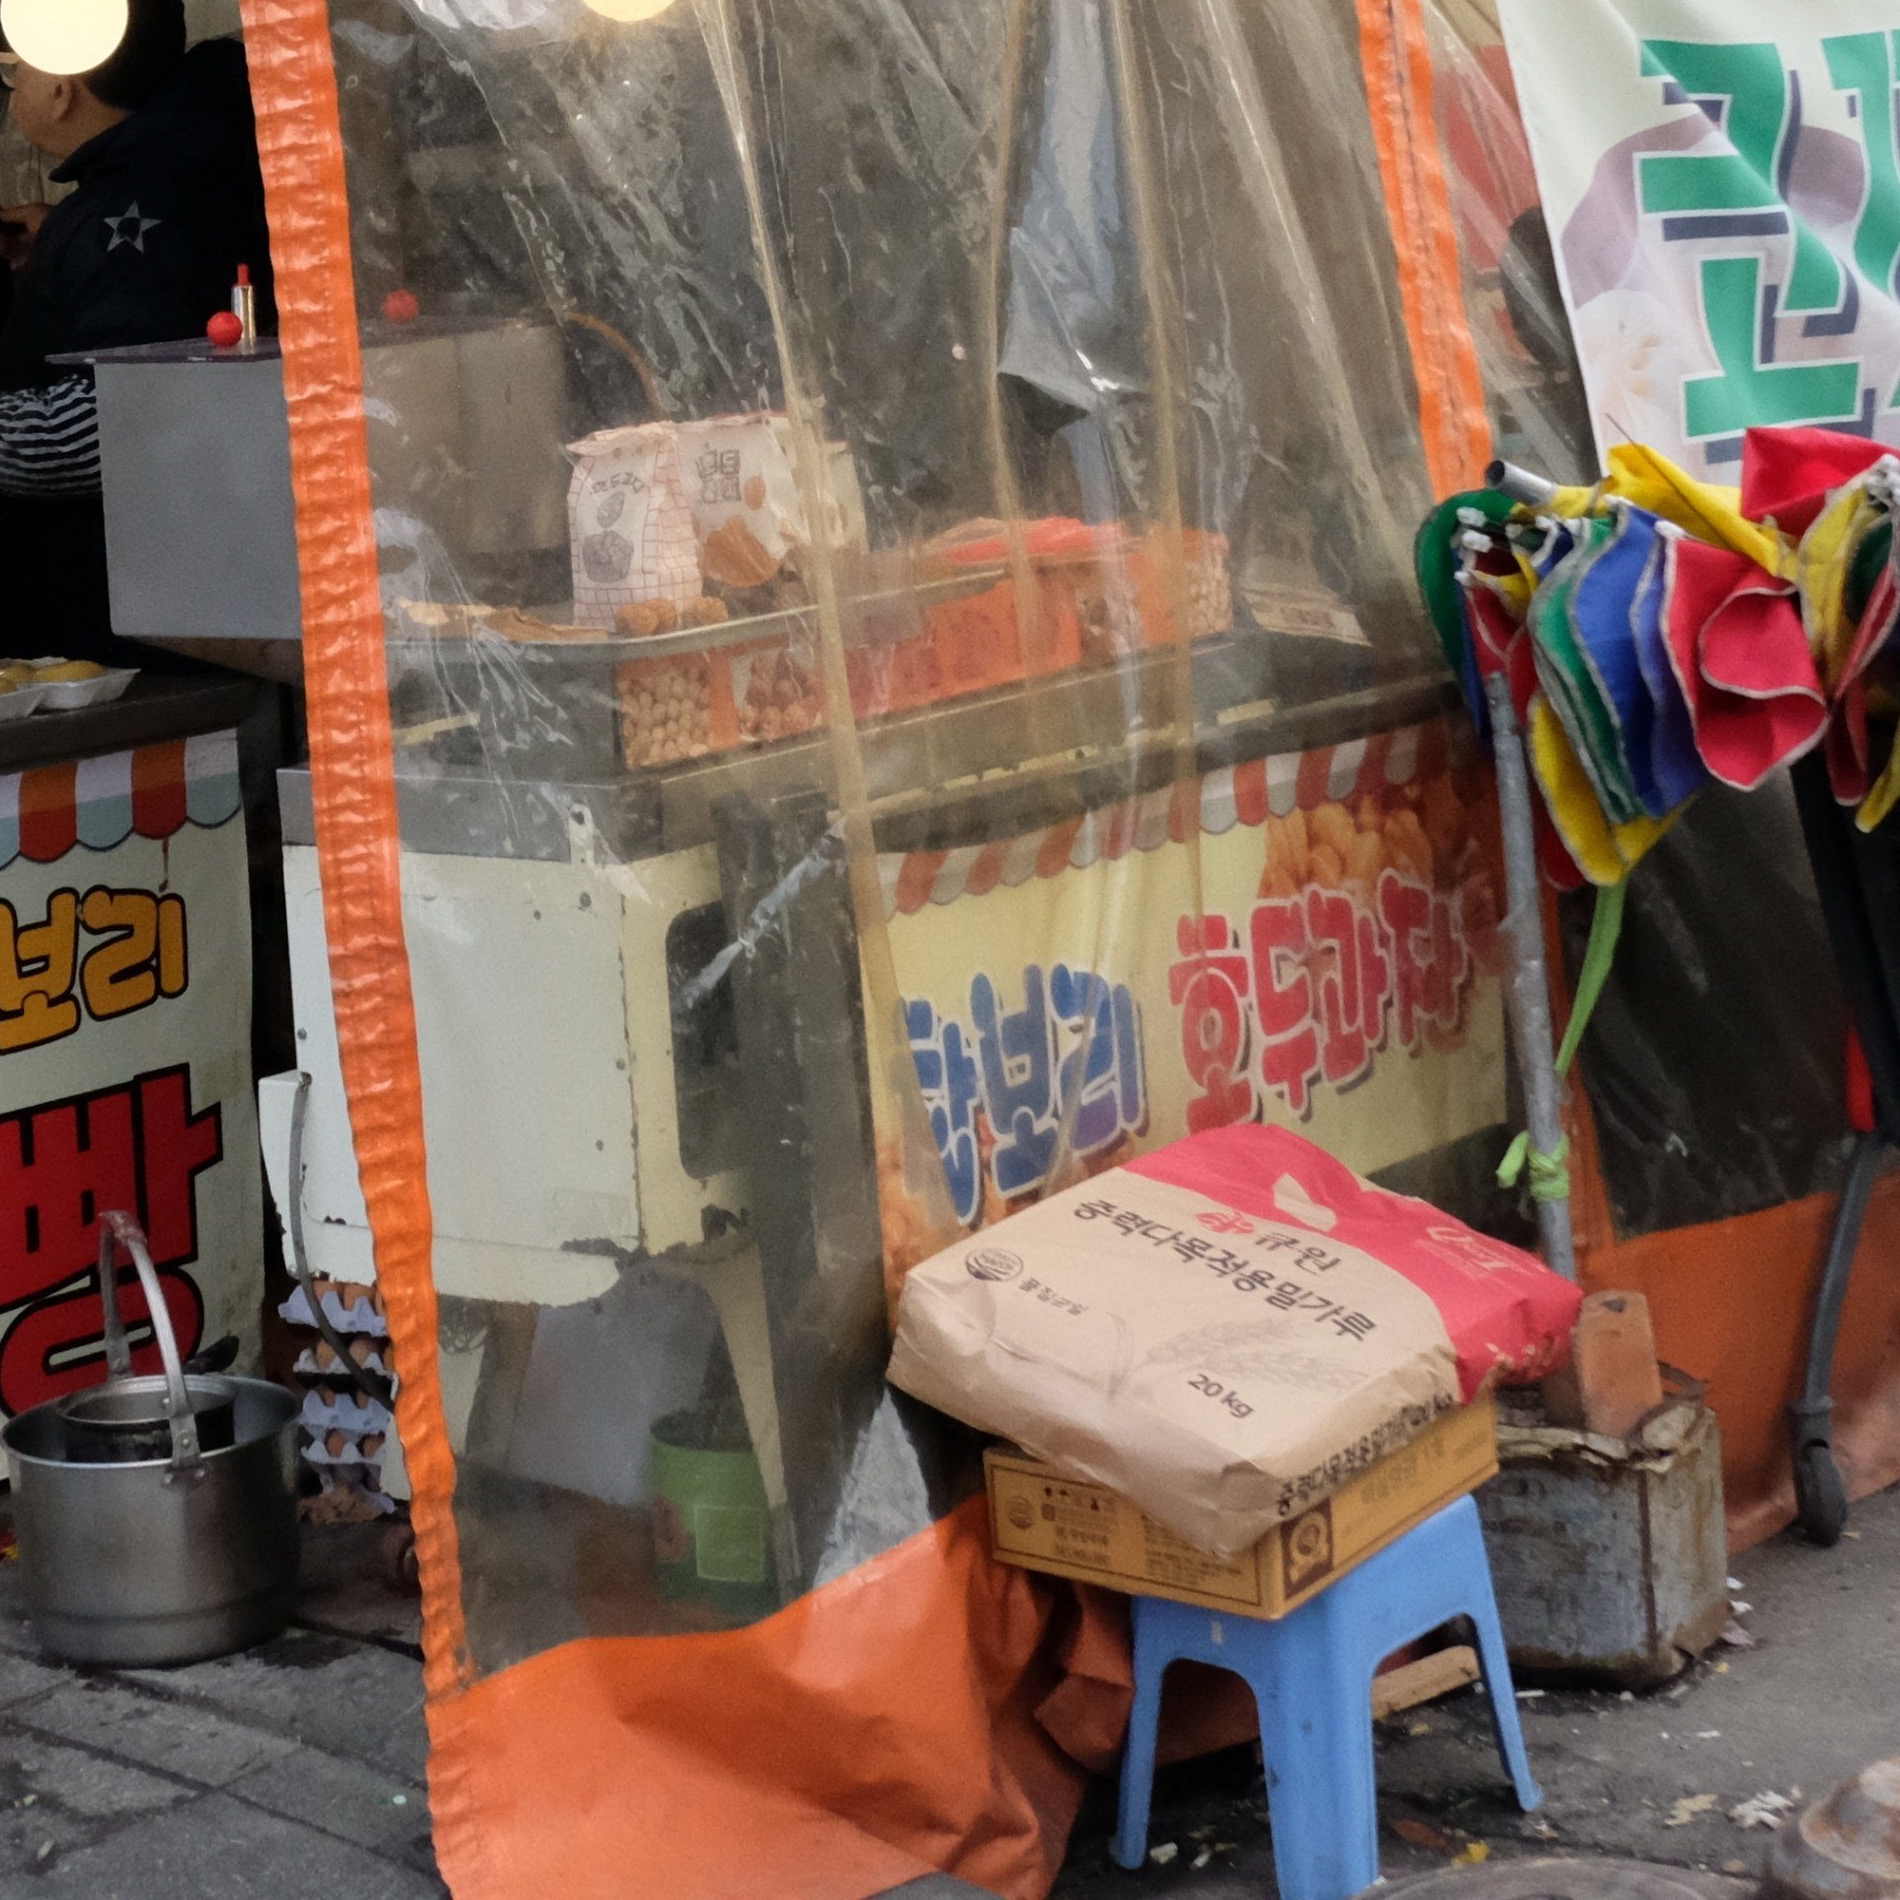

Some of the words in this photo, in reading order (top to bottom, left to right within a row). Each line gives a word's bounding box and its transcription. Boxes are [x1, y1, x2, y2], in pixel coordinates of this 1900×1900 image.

[1167, 869, 1478, 1144] 호두과자
[1072, 1198, 1378, 1343] 중력다목적용밀가루
[1254, 1230, 1342, 1275] 큐원
